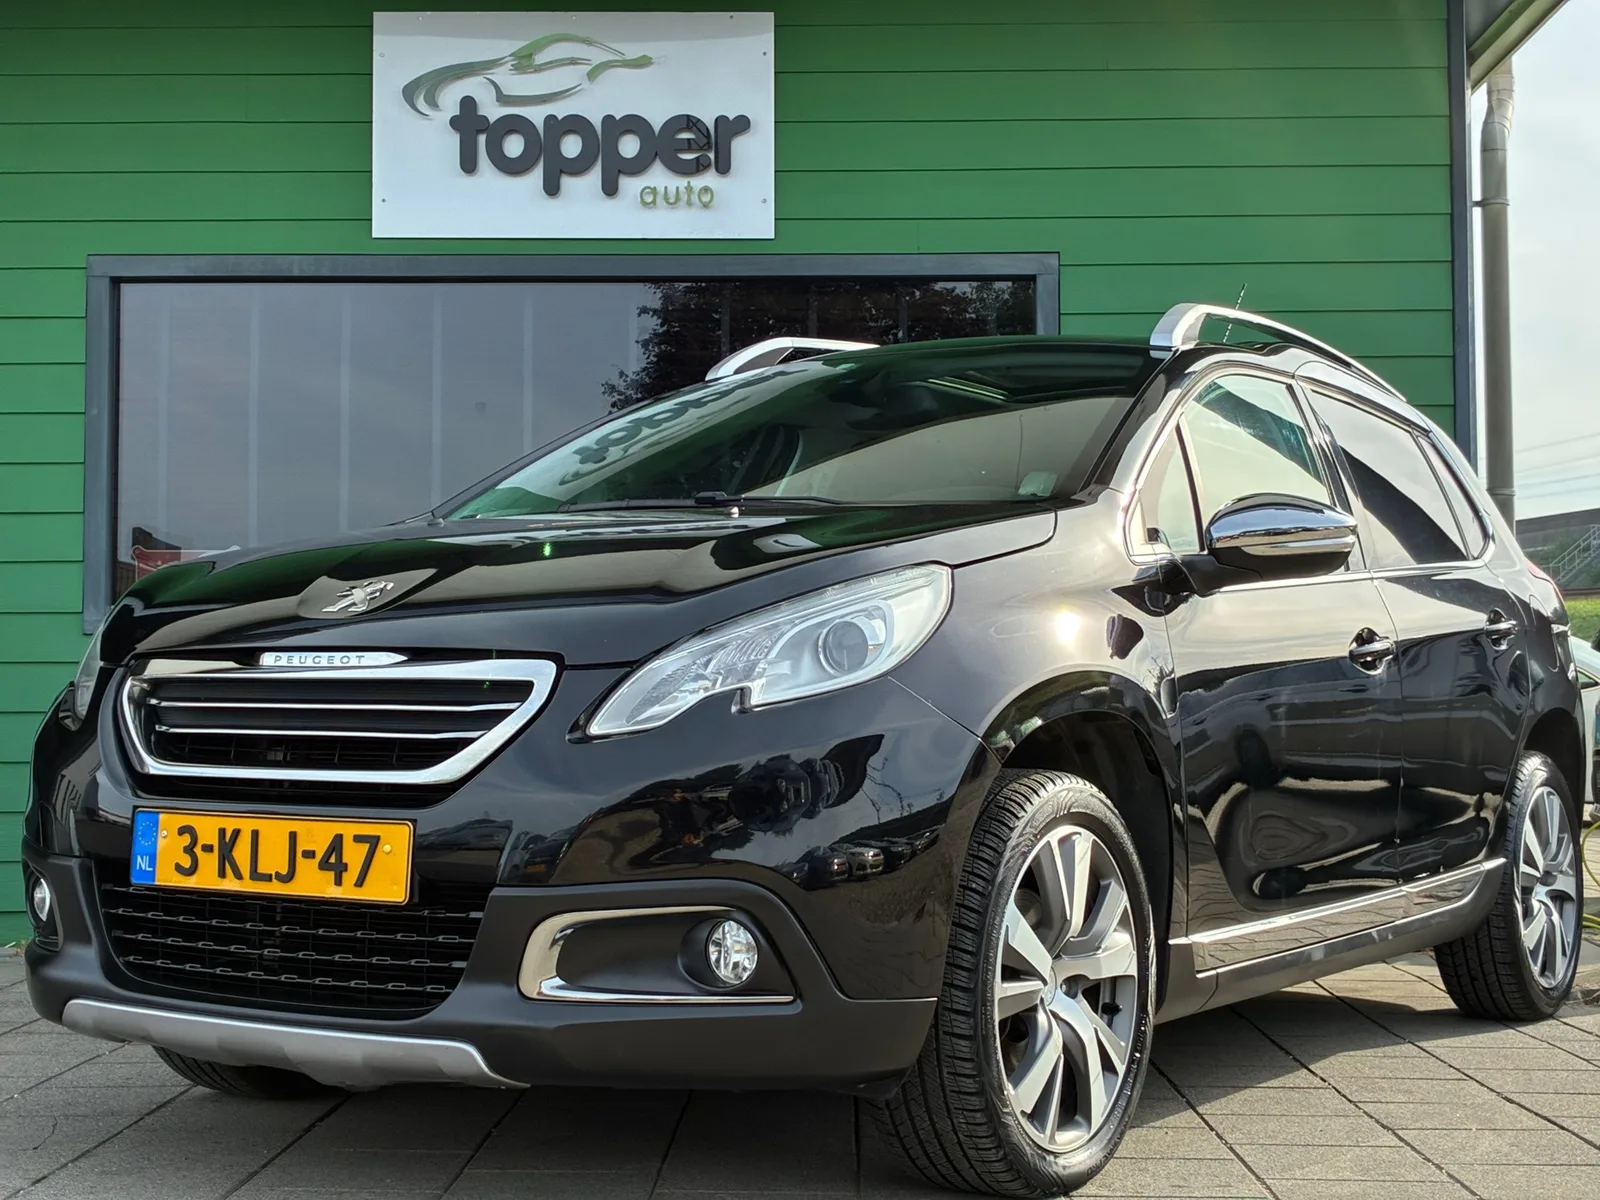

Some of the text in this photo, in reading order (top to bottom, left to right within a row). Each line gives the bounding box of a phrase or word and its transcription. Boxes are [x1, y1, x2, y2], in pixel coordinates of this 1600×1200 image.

[449, 95, 751, 197] topper
[639, 180, 715, 208] auto
[273, 655, 366, 665] PEUGEOT
[136, 855, 153, 872] NL
[174, 824, 381, 888] 3-KLJ-47
